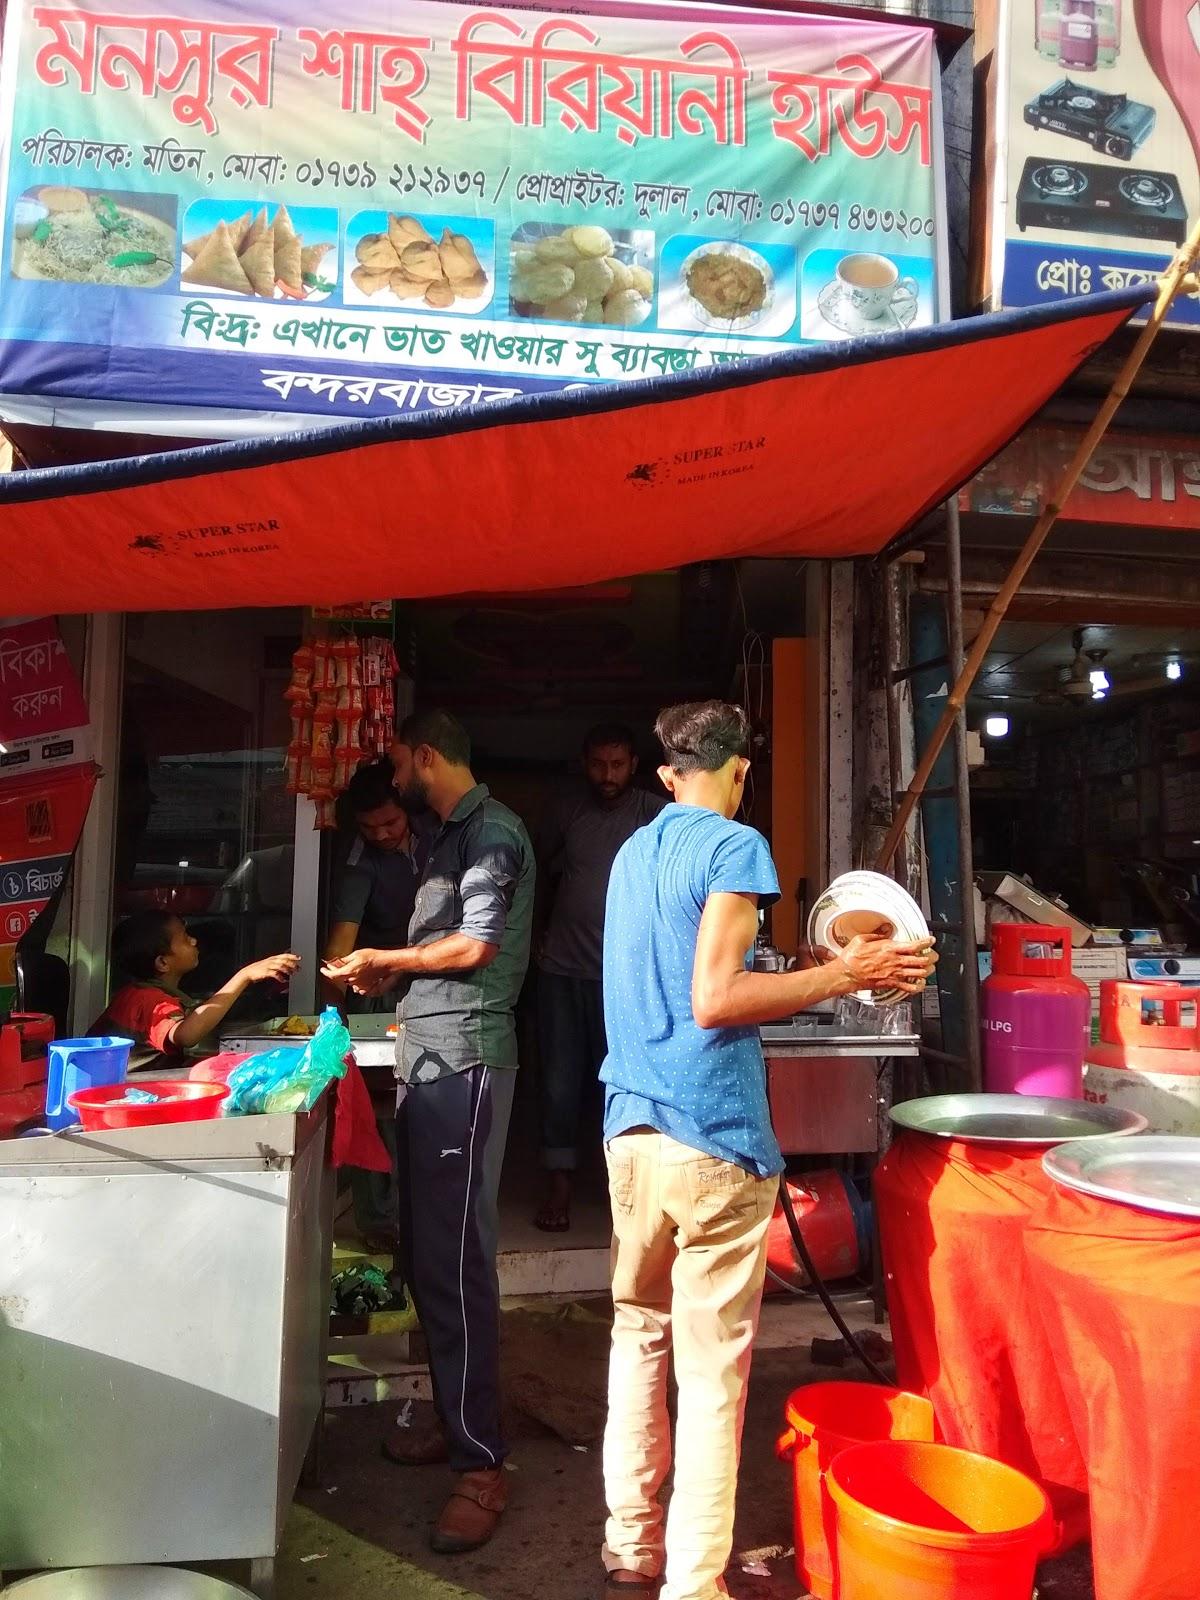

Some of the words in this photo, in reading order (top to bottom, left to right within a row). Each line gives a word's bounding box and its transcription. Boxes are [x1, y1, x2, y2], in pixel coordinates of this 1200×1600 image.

[33, 7, 280, 135] মনসুর
[298, 28, 433, 144] শাহ্
[450, 12, 752, 146] বিরিয়ানী
[767, 53, 933, 166] হাউস
[296, 159, 377, 190] ০১৭৩৯
[389, 162, 487, 199] ২১২৯৩৭
[769, 198, 840, 231] ০১৭৩৭
[847, 202, 935, 240] ৪৩৩২০০
[273, 316, 376, 354] এখানে
[382, 323, 453, 357] ভাত
[460, 329, 571, 367] খাওয়ার
[575, 340, 604, 378] সু
[673, 446, 724, 465] SUPER
[677, 474, 706, 485] MADE
[720, 463, 754, 478] KOREA
[176, 525, 233, 541] SUPER
[236, 519, 281, 535] STAR
[194, 548, 228, 558] MADE
[242, 543, 280, 554] KOREA
[12, 685, 64, 719] করুন
[990, 1019, 1012, 1033] LPG
